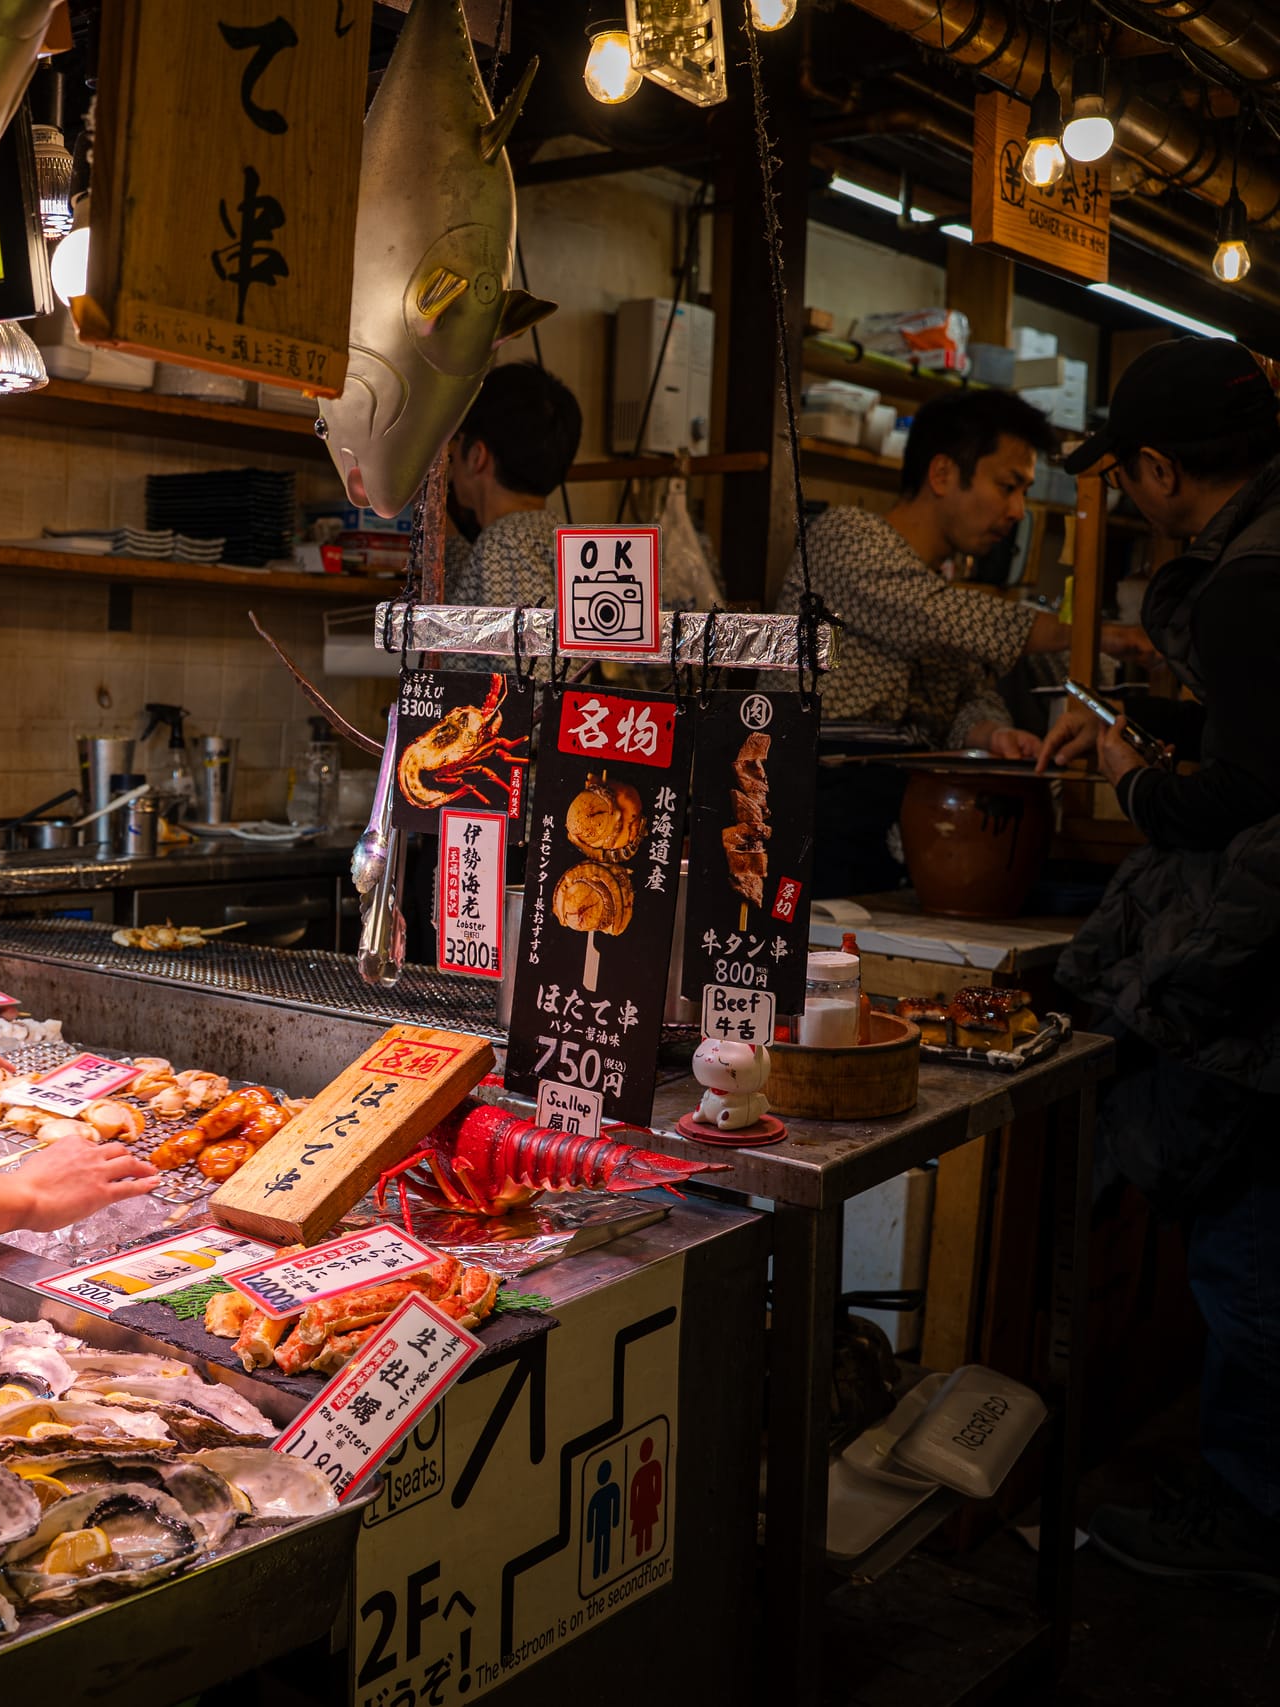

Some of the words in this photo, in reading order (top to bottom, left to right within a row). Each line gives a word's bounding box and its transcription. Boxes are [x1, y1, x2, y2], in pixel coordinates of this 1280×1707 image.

[1029, 205, 1061, 238] CASHIER
[402, 683, 445, 698] 伊勢えび
[568, 699, 658, 757] 名物
[645, 786, 678, 893] 北海道産
[461, 822, 483, 919] 伊勢海老
[528, 814, 555, 966] 帆立センター長おすすめ
[776, 883, 796, 917] 厚切
[456, 920, 486, 931] Lobster
[701, 928, 789, 964] 牛タン串
[537, 984, 640, 1034] ほたて串
[713, 989, 761, 1014] Beef
[549, 1019, 621, 1048] バター醤油味
[715, 1016, 756, 1040] 牛舌
[65, 1064, 116, 1089] ほたて串
[379, 1046, 440, 1075] 名物
[547, 1091, 592, 1118] Scallop
[264, 1082, 399, 1199] ほたて串
[306, 1241, 402, 1280] たらばがに
[347, 1328, 438, 1427] 生牡蠣
[319, 1406, 335, 1423] Raw
[336, 1423, 372, 1456] oysters
[952, 1396, 1012, 1451] RESERVED
[394, 1457, 441, 1498] seats.
[358, 1560, 477, 1690] 2Fへ
[475, 1662, 499, 1688] The
[557, 1619, 567, 1639] is
[570, 1609, 584, 1632] on
[587, 1597, 605, 1621] the
